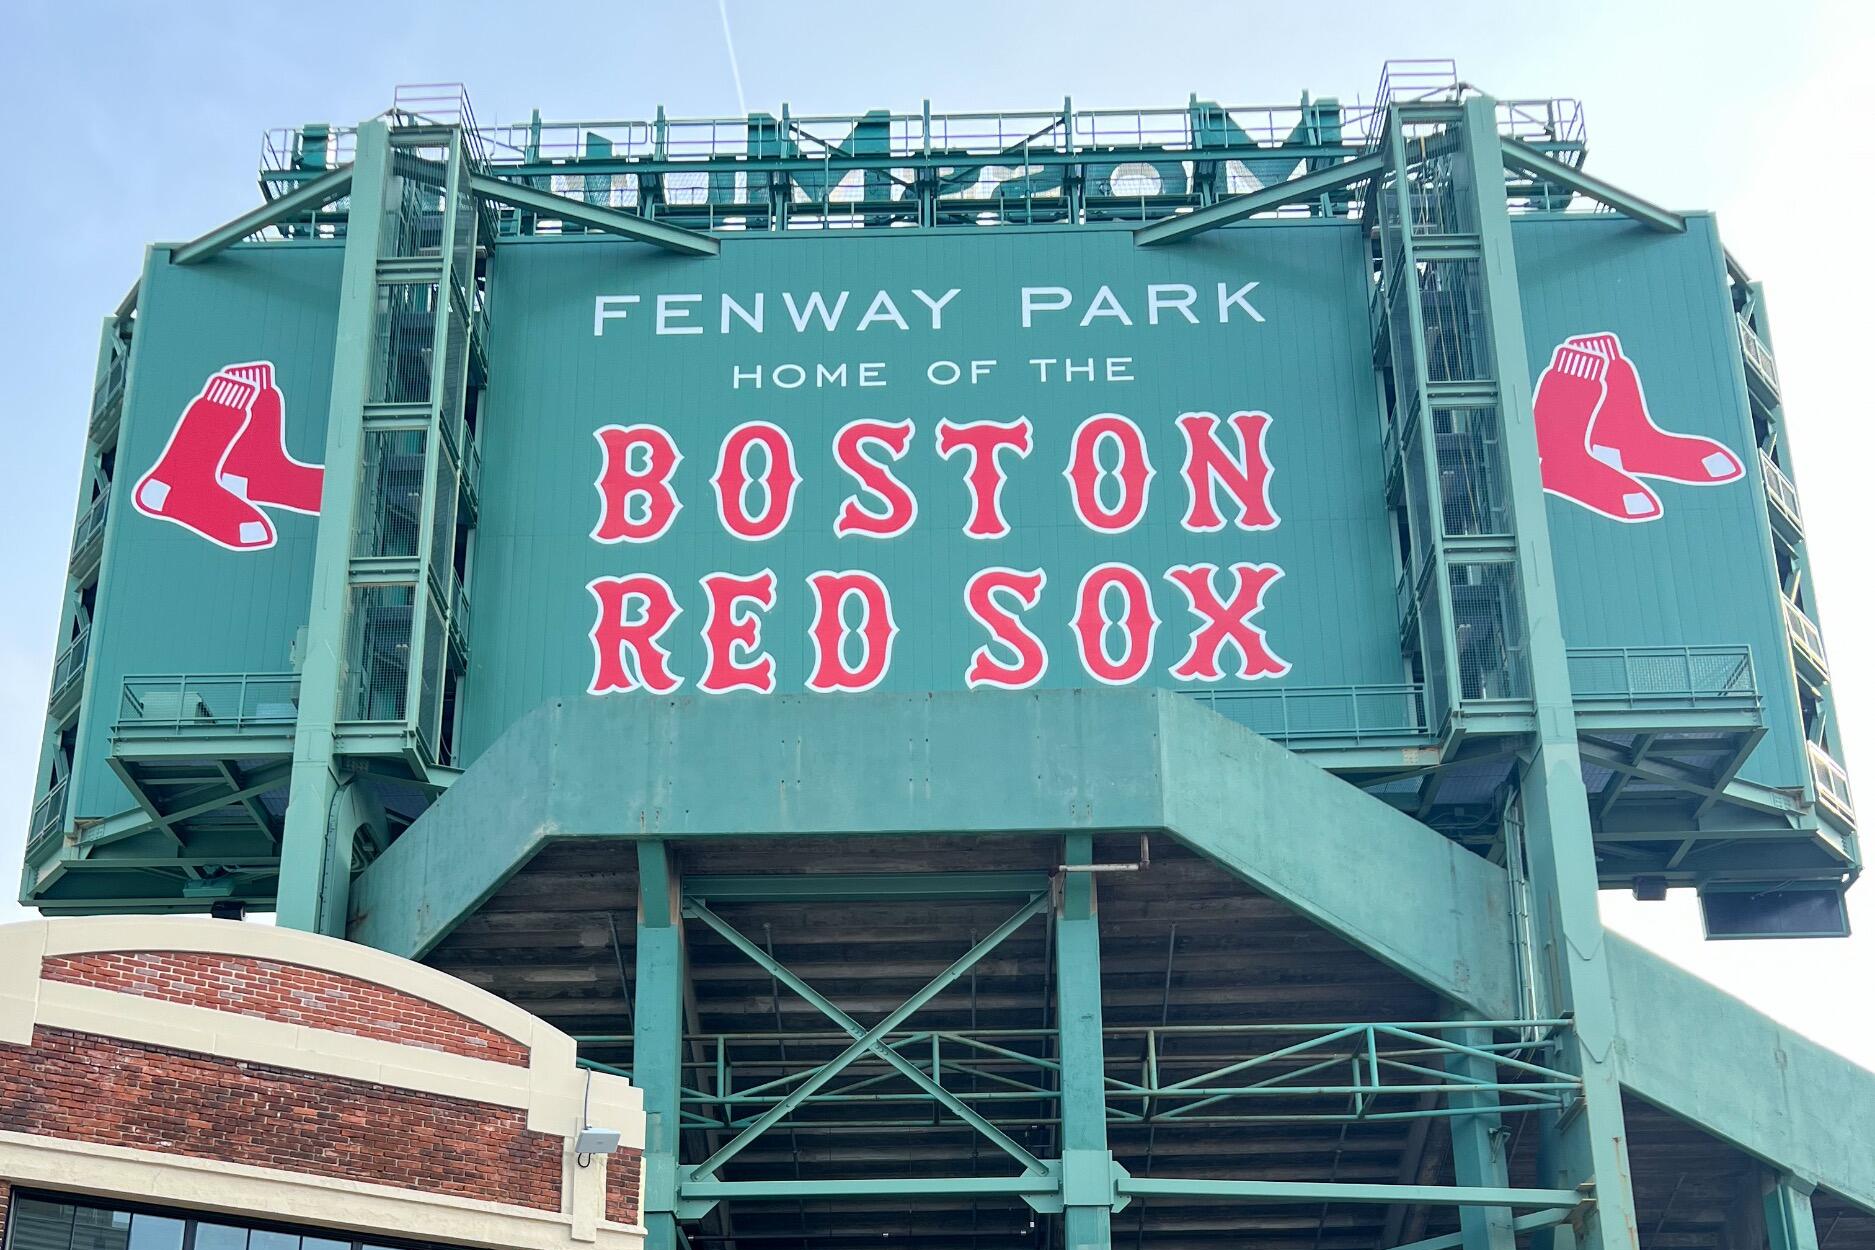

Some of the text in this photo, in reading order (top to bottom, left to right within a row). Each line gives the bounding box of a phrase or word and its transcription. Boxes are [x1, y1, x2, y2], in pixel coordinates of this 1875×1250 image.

[593, 281, 1267, 337] FENWAY PARK
[732, 356, 1136, 390] HOME OF THE
[588, 409, 1282, 545] BOSTON
[585, 561, 1294, 696] RED SOX
